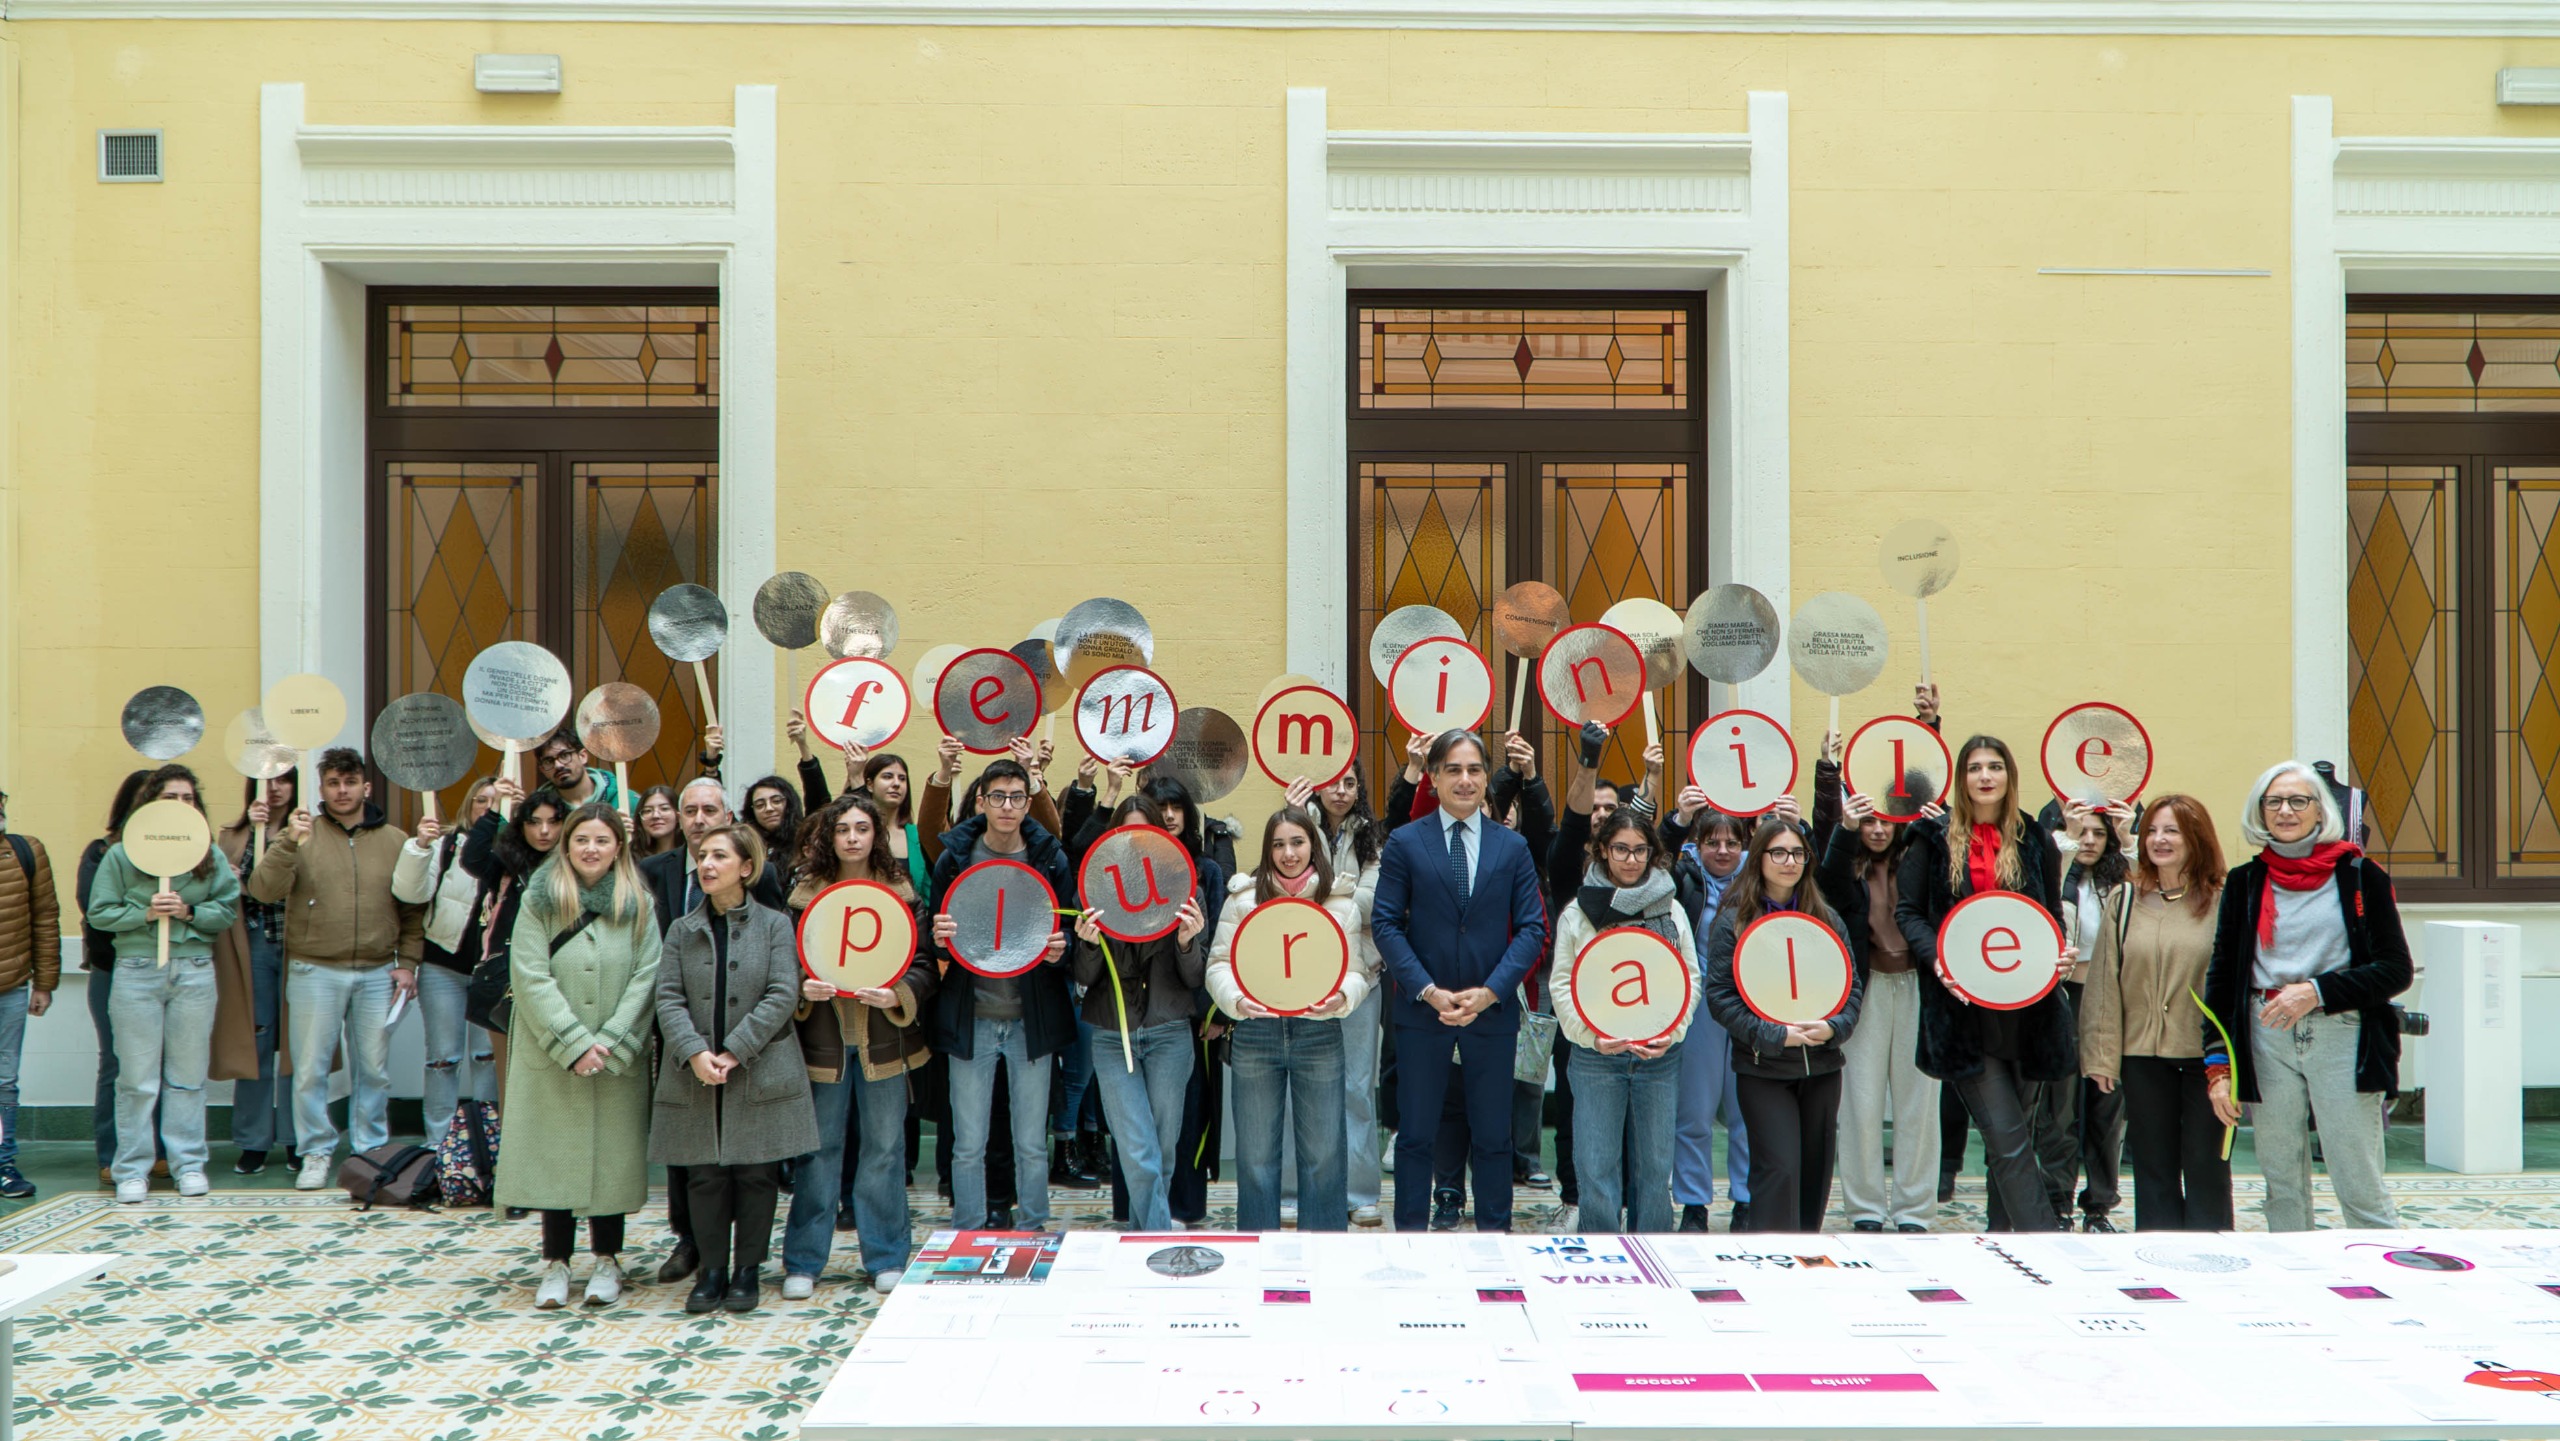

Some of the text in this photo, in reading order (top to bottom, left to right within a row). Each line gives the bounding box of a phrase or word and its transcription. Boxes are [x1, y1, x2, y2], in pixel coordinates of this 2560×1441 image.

[1897, 550, 1939, 562] INCLUSIONE
[842, 627, 879, 636] TENEREZZA
[1090, 633, 1133, 642] LIBERAZIONE
[1505, 614, 1557, 626] COMPRENSIONE
[1702, 634, 1737, 642] VOGLIAMO
[1104, 646, 1133, 654] GRIDALO
[1702, 640, 1736, 648] VOGLIAMO
[486, 668, 509, 676] GENIO
[510, 670, 532, 680] DELLE
[488, 674, 515, 682] INVADE
[509, 689, 538, 698] GIORNO
[1437, 656, 1451, 713] i
[1569, 655, 1614, 703] n
[474, 696, 500, 706] DONNA
[836, 680, 884, 730] f
[970, 675, 1010, 726] e
[1097, 692, 1157, 734] m
[1278, 713, 1333, 756] m
[1729, 727, 1757, 789] i
[2075, 736, 2113, 778] e
[1103, 856, 1170, 914] u
[838, 906, 883, 967] p
[1283, 932, 1308, 979] r
[1982, 927, 2021, 973] e
[1612, 960, 1649, 1007] a
